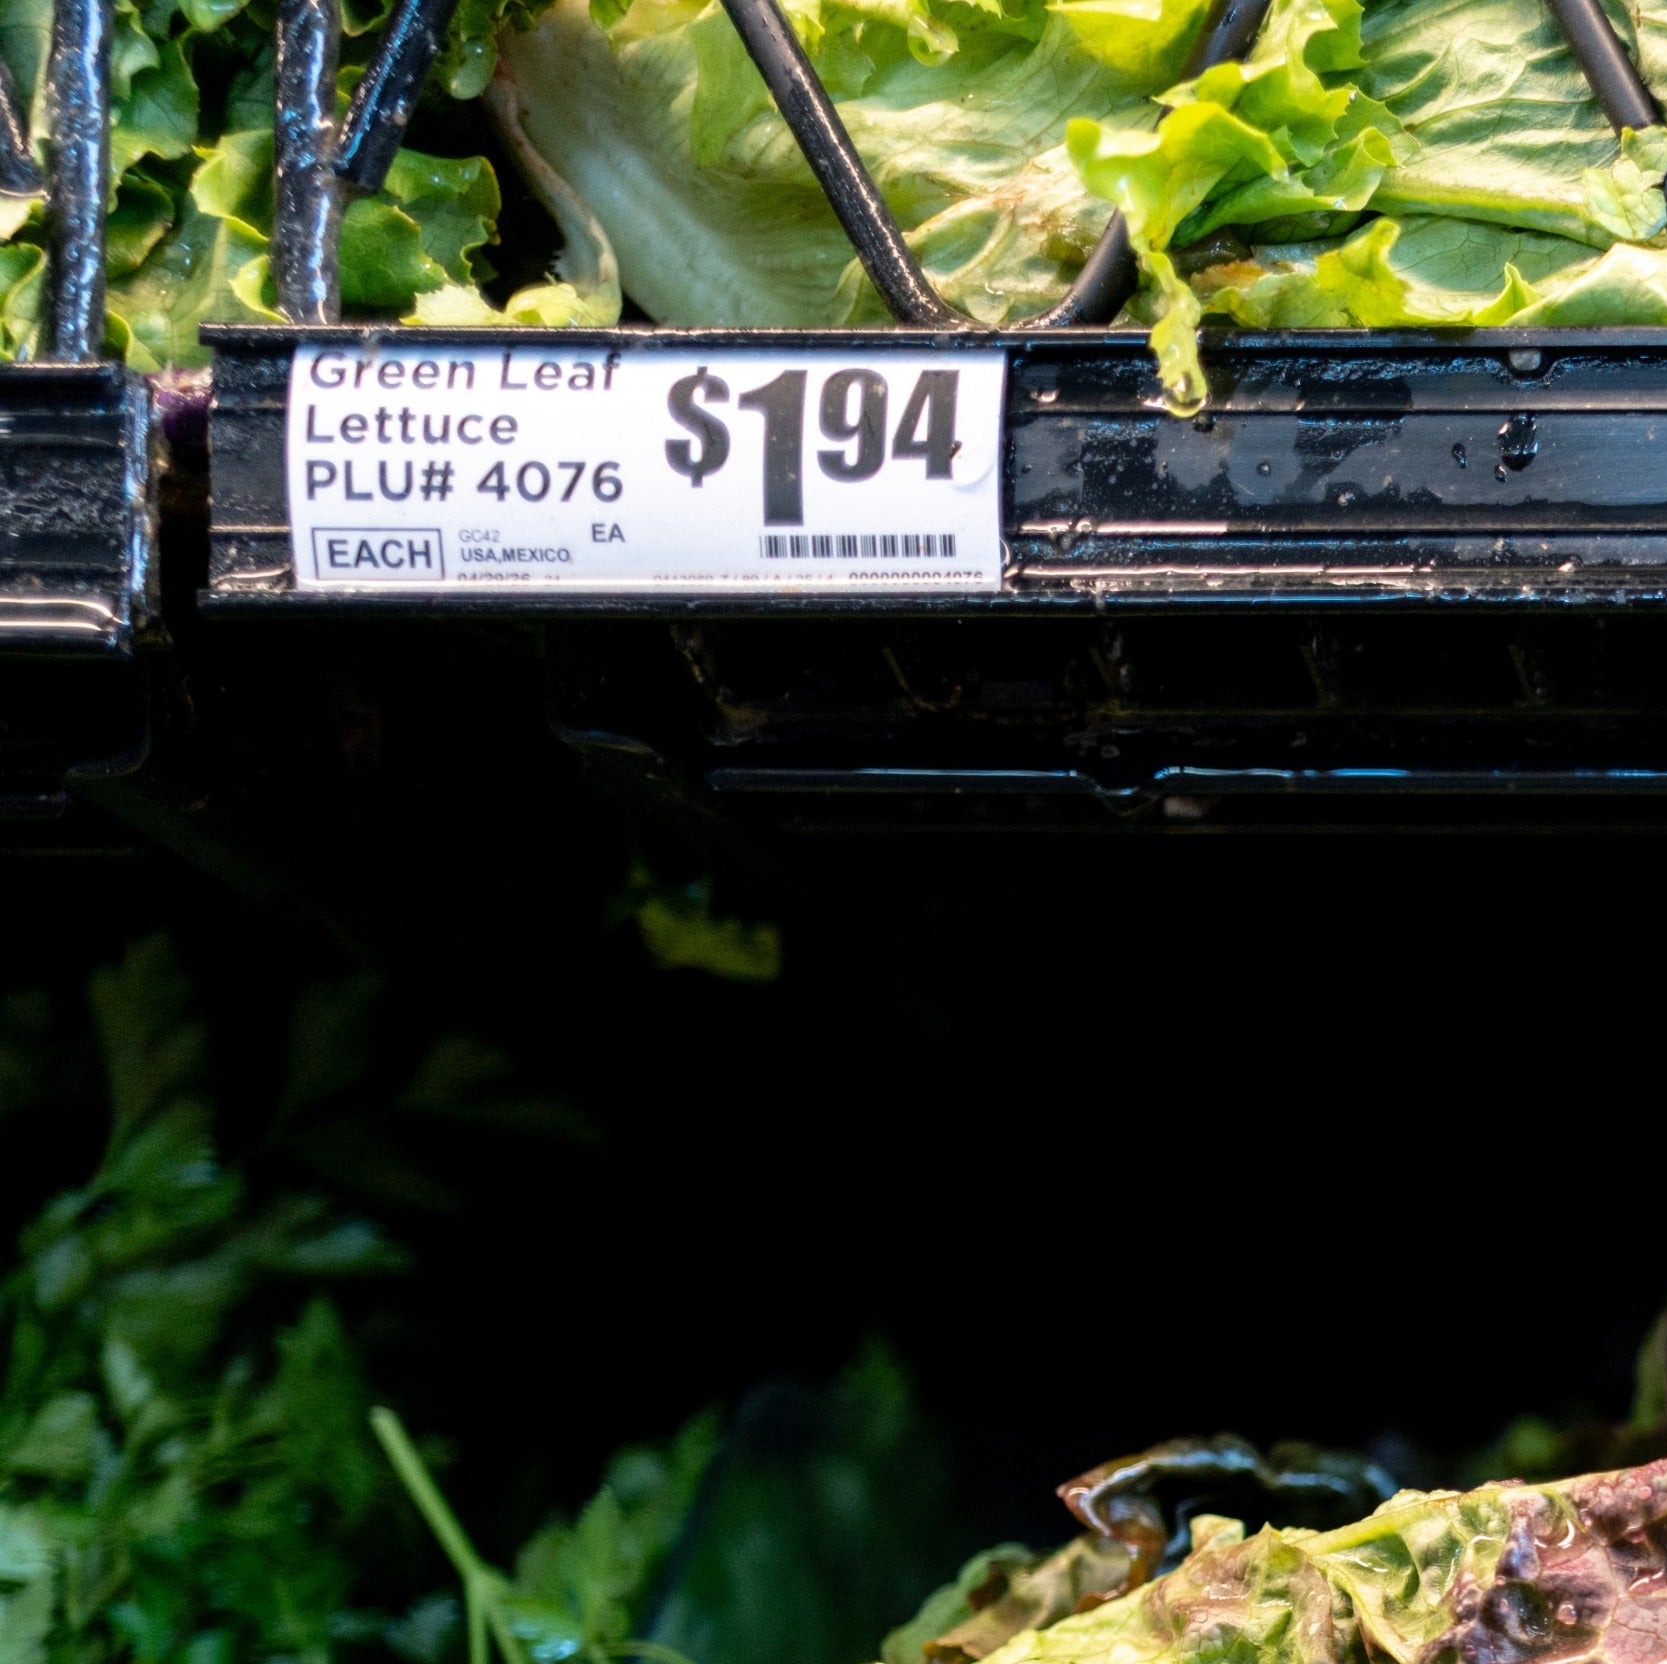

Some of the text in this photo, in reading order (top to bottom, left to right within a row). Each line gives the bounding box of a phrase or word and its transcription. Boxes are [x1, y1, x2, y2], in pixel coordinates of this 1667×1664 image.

[310, 354, 622, 390] Green Leaf
[306, 404, 518, 445] Lettuce
[306, 460, 624, 503] PLU# 4076
[458, 529, 502, 545] GC42
[591, 522, 626, 544] EA
[327, 538, 433, 570] EACH
